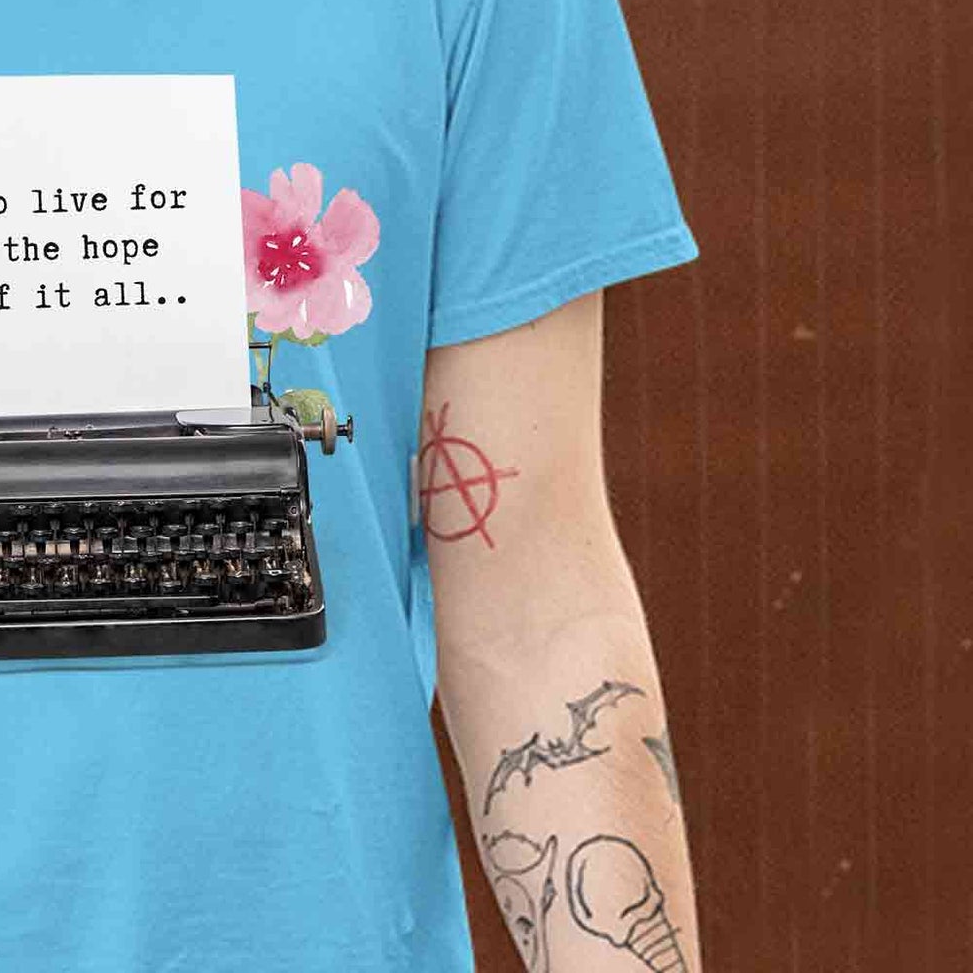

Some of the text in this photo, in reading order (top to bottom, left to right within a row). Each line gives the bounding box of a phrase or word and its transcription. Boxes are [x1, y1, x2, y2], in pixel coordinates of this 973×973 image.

[31, 188, 108, 214] live
[130, 183, 187, 211] for
[3, 234, 159, 266] the hope
[35, 282, 71, 309] it
[94, 281, 187, 307] all..
